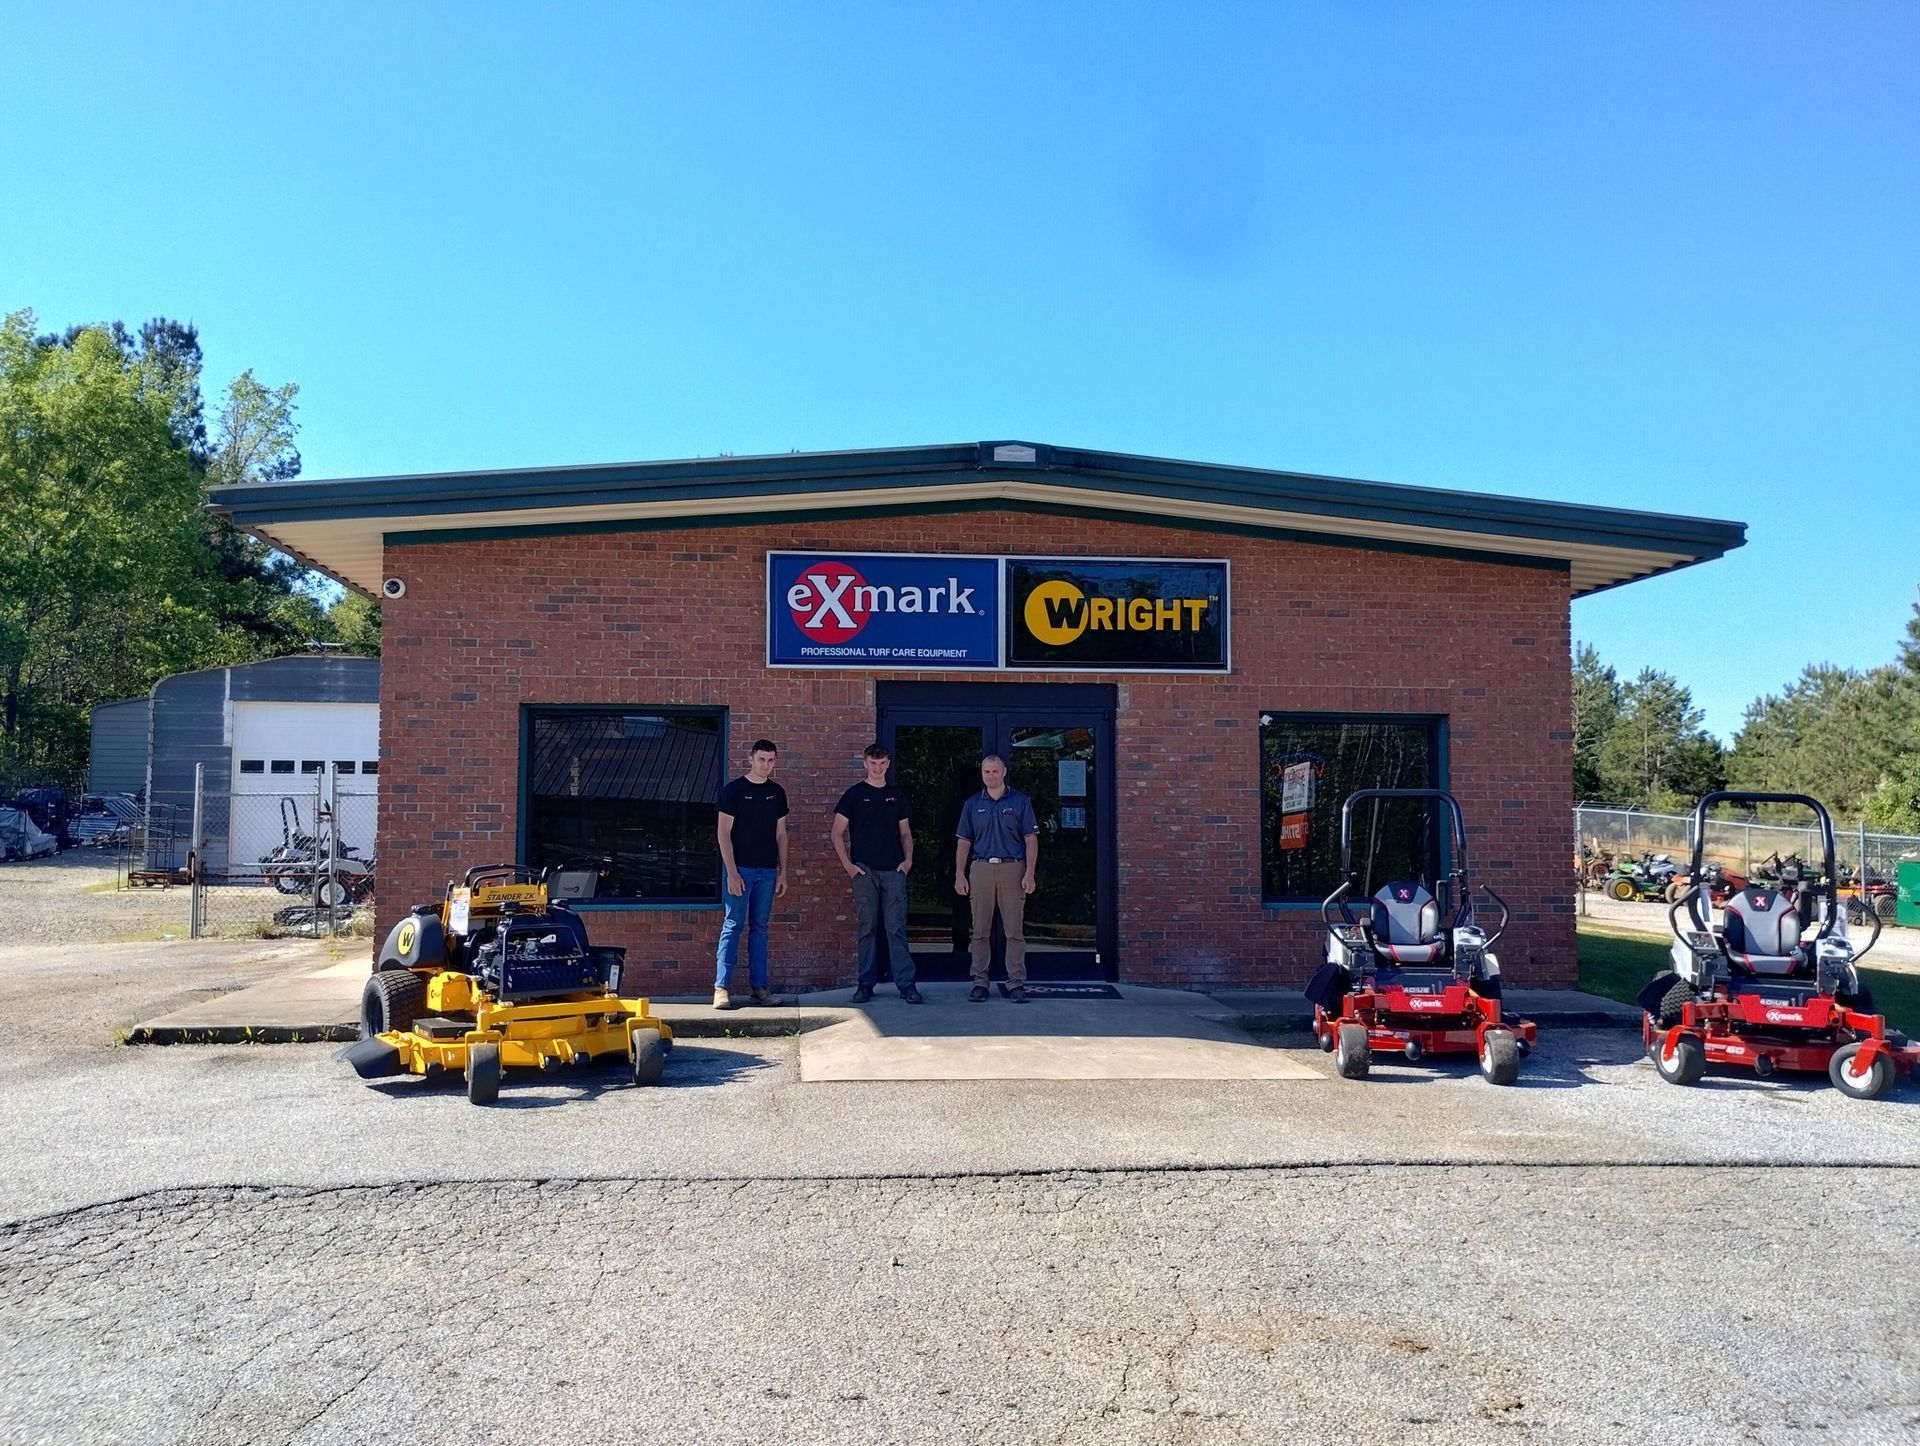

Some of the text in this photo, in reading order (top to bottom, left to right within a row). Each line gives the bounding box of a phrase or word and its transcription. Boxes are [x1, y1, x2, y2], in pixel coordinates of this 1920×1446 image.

[787, 574, 976, 629] eXmark
[1044, 597, 1208, 631] WRIGHT
[801, 647, 968, 658] PROFESSIONAL TURF CARE EQUIPMENT
[486, 893, 522, 901] STANDER
[402, 931, 415, 947] W
